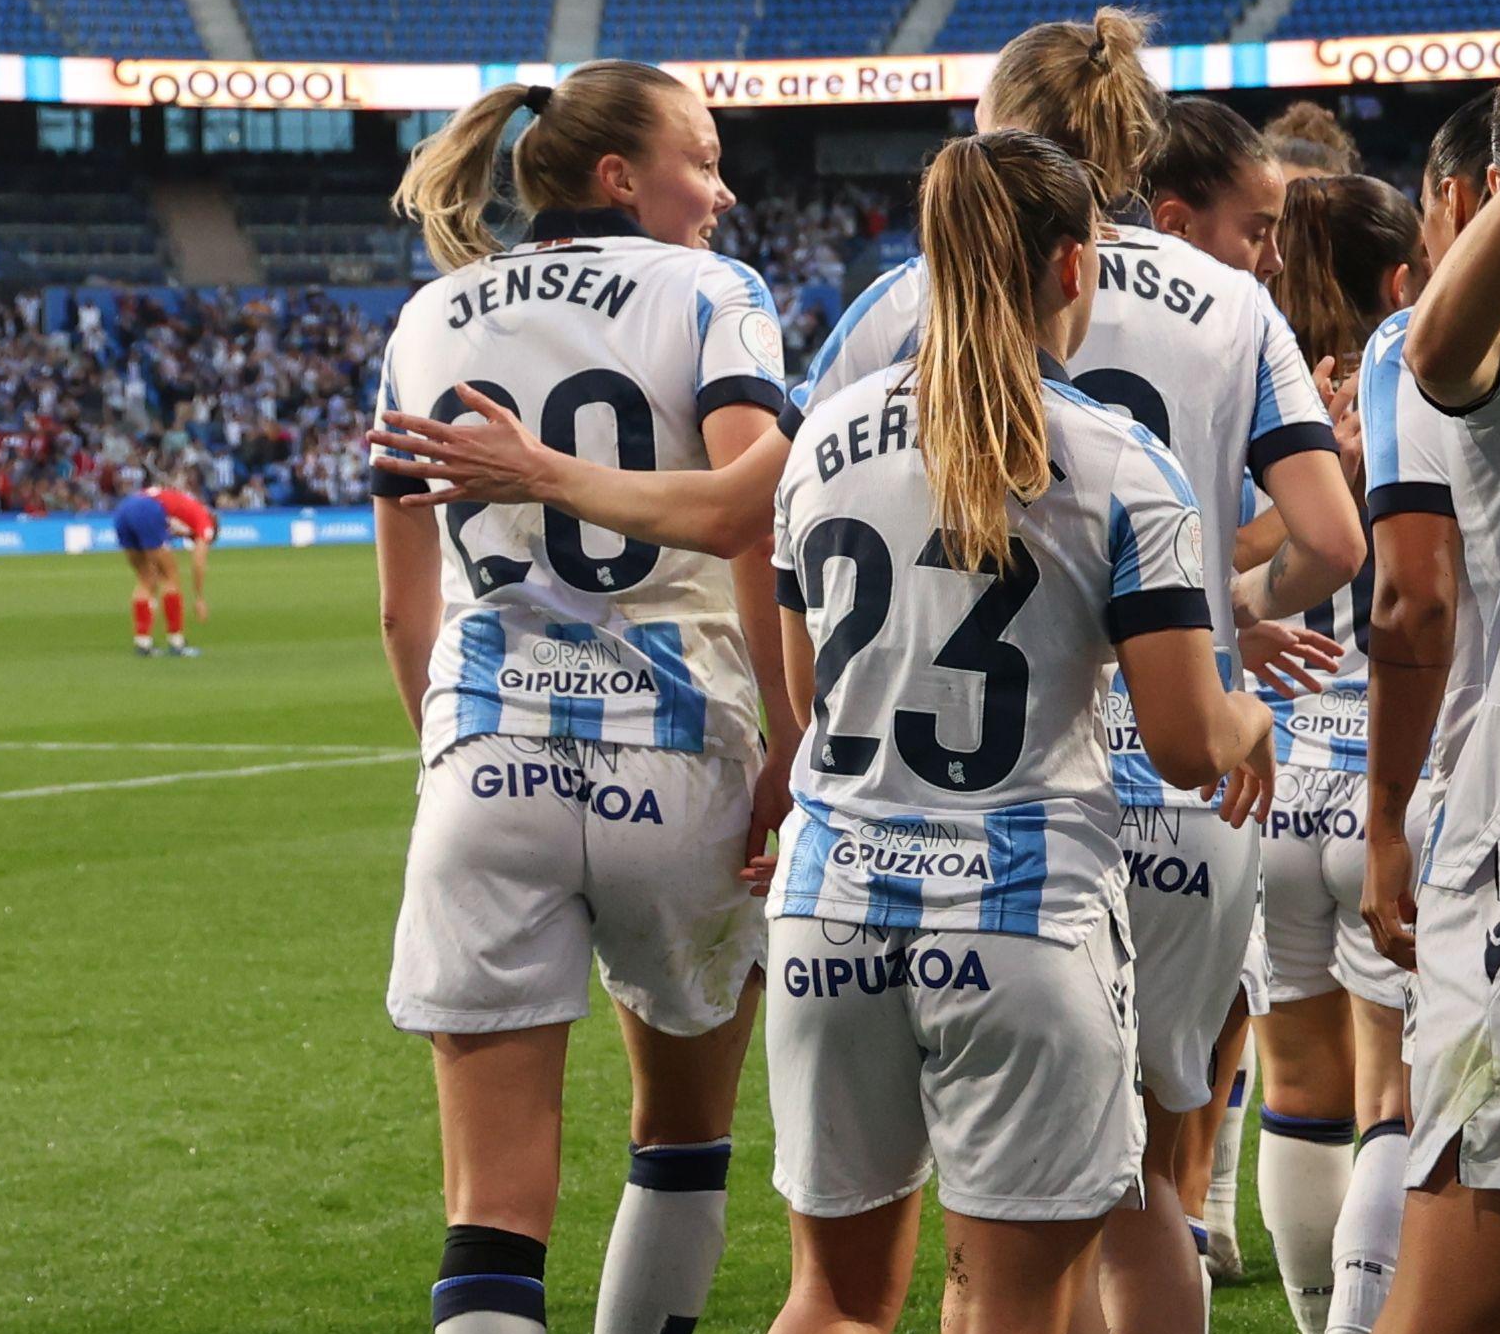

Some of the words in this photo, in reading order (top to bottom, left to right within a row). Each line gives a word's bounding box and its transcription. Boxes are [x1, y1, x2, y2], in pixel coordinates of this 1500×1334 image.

[700, 70, 762, 100] We
[777, 73, 846, 97] are
[856, 62, 946, 97] Real
[448, 262, 638, 330] JENSEN
[1098, 253, 1215, 325] NSSI
[430, 369, 661, 598] 20
[532, 640, 622, 667] ORAIN
[803, 517, 1041, 792] 23
[500, 668, 656, 695] GIPUZKOA
[1290, 715, 1368, 738] GIPUZ
[784, 947, 991, 998] GIPUZKOA
